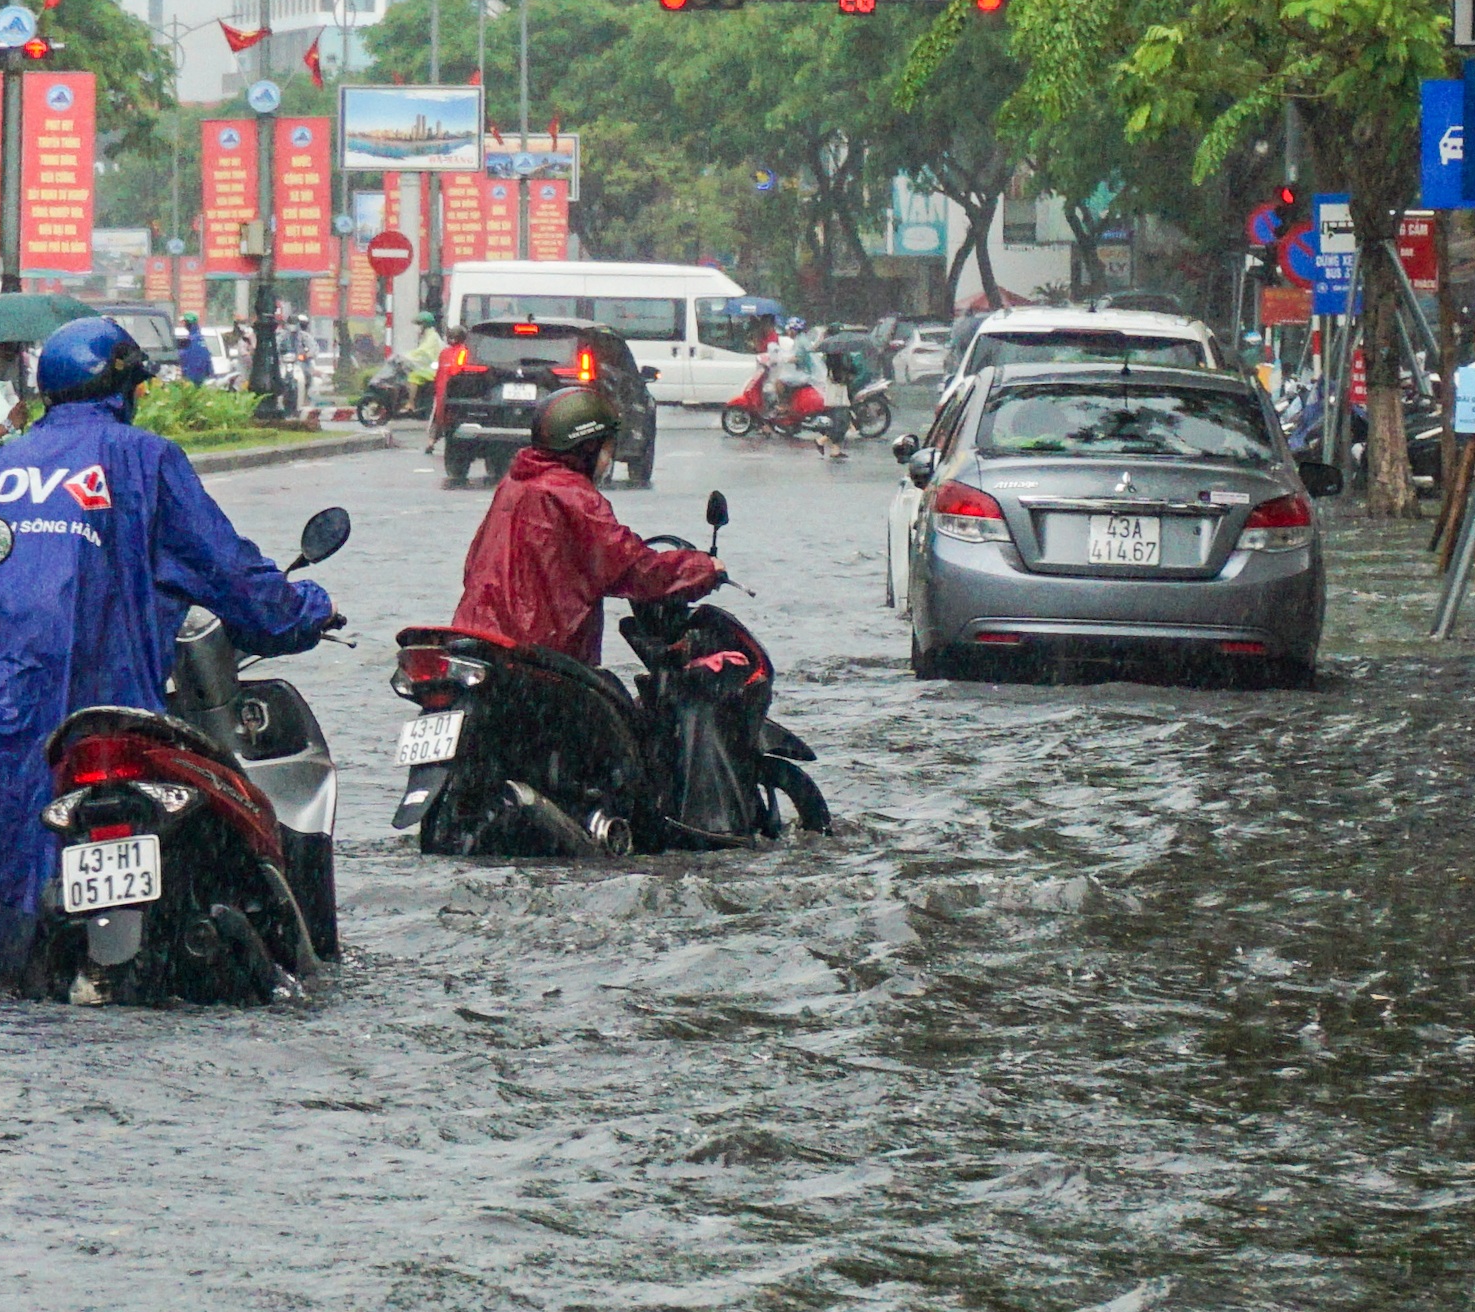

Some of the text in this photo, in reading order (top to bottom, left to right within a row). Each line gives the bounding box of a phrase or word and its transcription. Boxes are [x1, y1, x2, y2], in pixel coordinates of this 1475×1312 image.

[20, 517, 102, 547] SÔNG HÀN
[1107, 517, 1142, 539] 43A
[1092, 540, 1156, 563] 414.67
[410, 714, 452, 740] 43-D1
[399, 736, 454, 763] 680.47
[78, 842, 141, 875] 43-H1
[71, 871, 153, 907] 051.23
